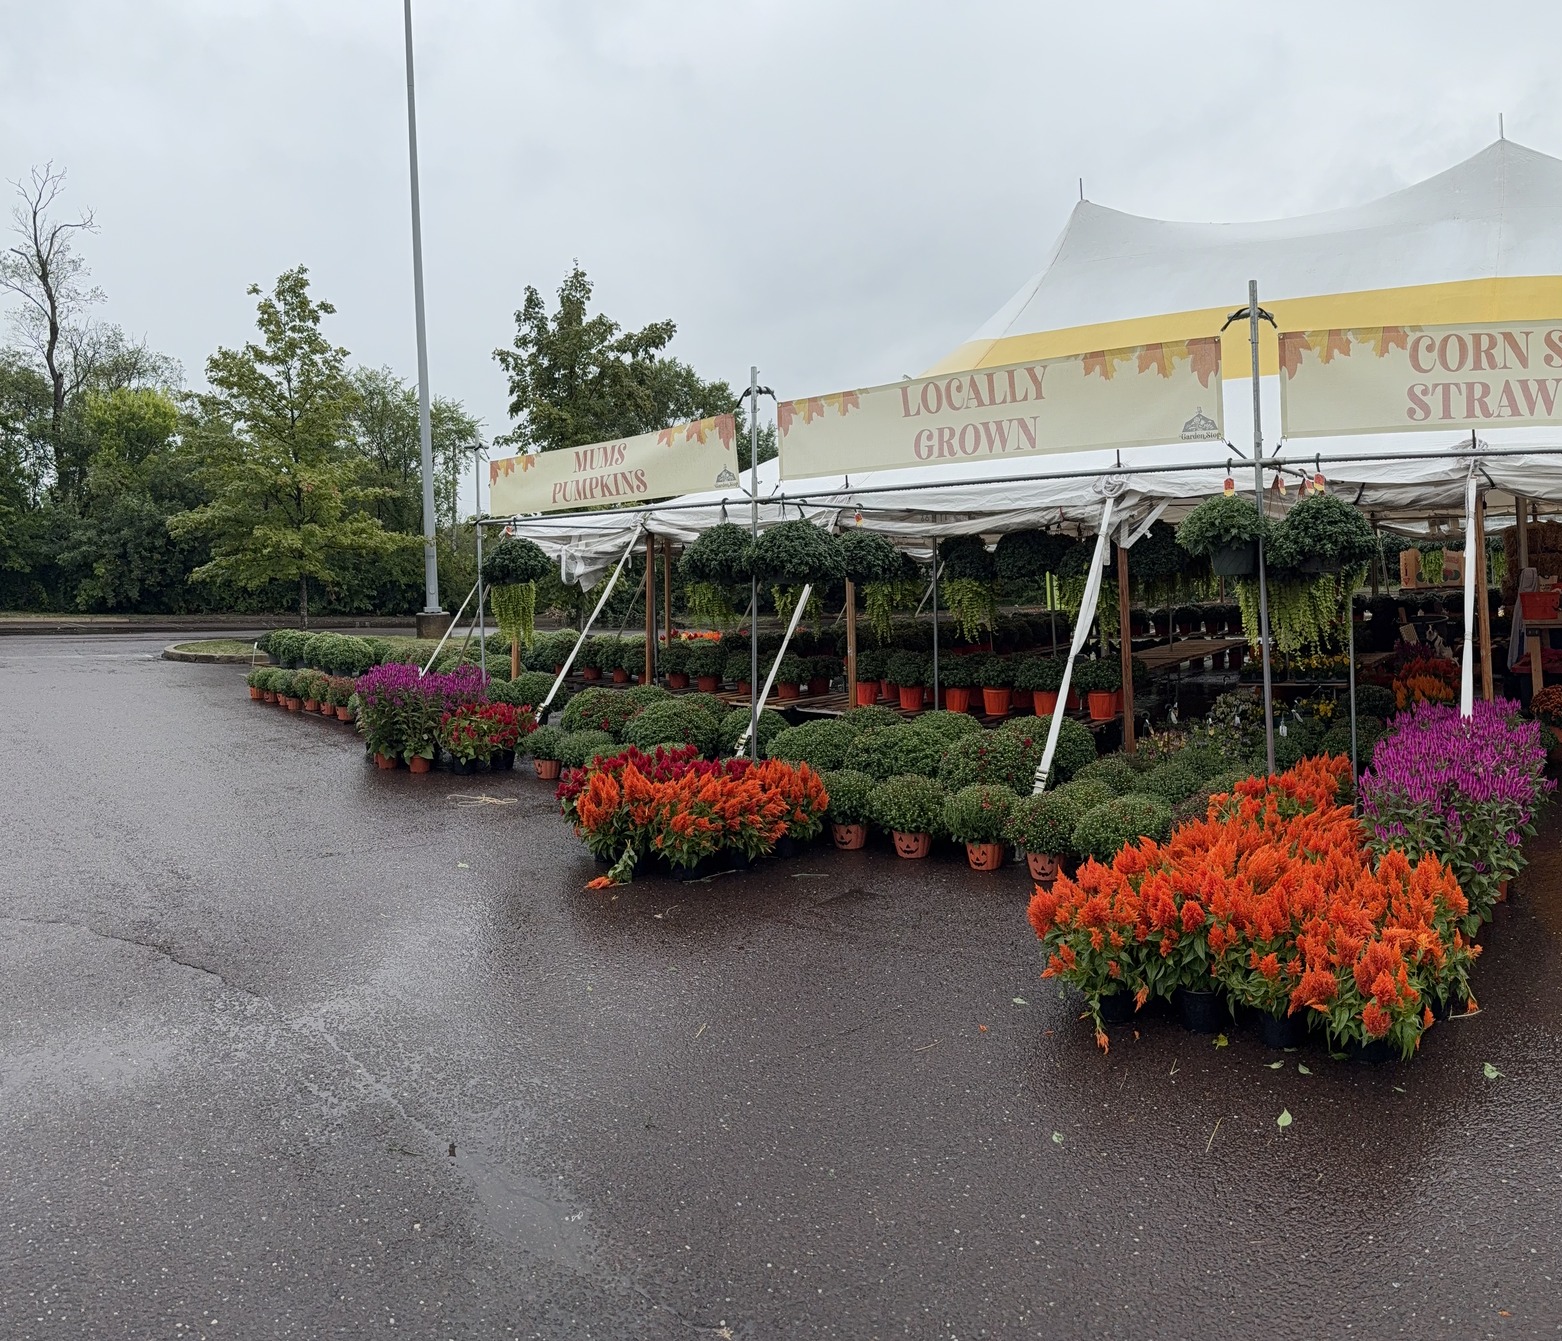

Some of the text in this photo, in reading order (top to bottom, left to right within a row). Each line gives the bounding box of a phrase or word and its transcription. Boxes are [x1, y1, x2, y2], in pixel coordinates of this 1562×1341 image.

[1409, 330, 1533, 373] CORN
[899, 365, 1048, 418] LOCALLY
[913, 415, 1040, 460] GROWN
[1180, 432, 1206, 441] Garden
[573, 443, 627, 472] MUMS
[551, 468, 648, 504] PUMPKINS
